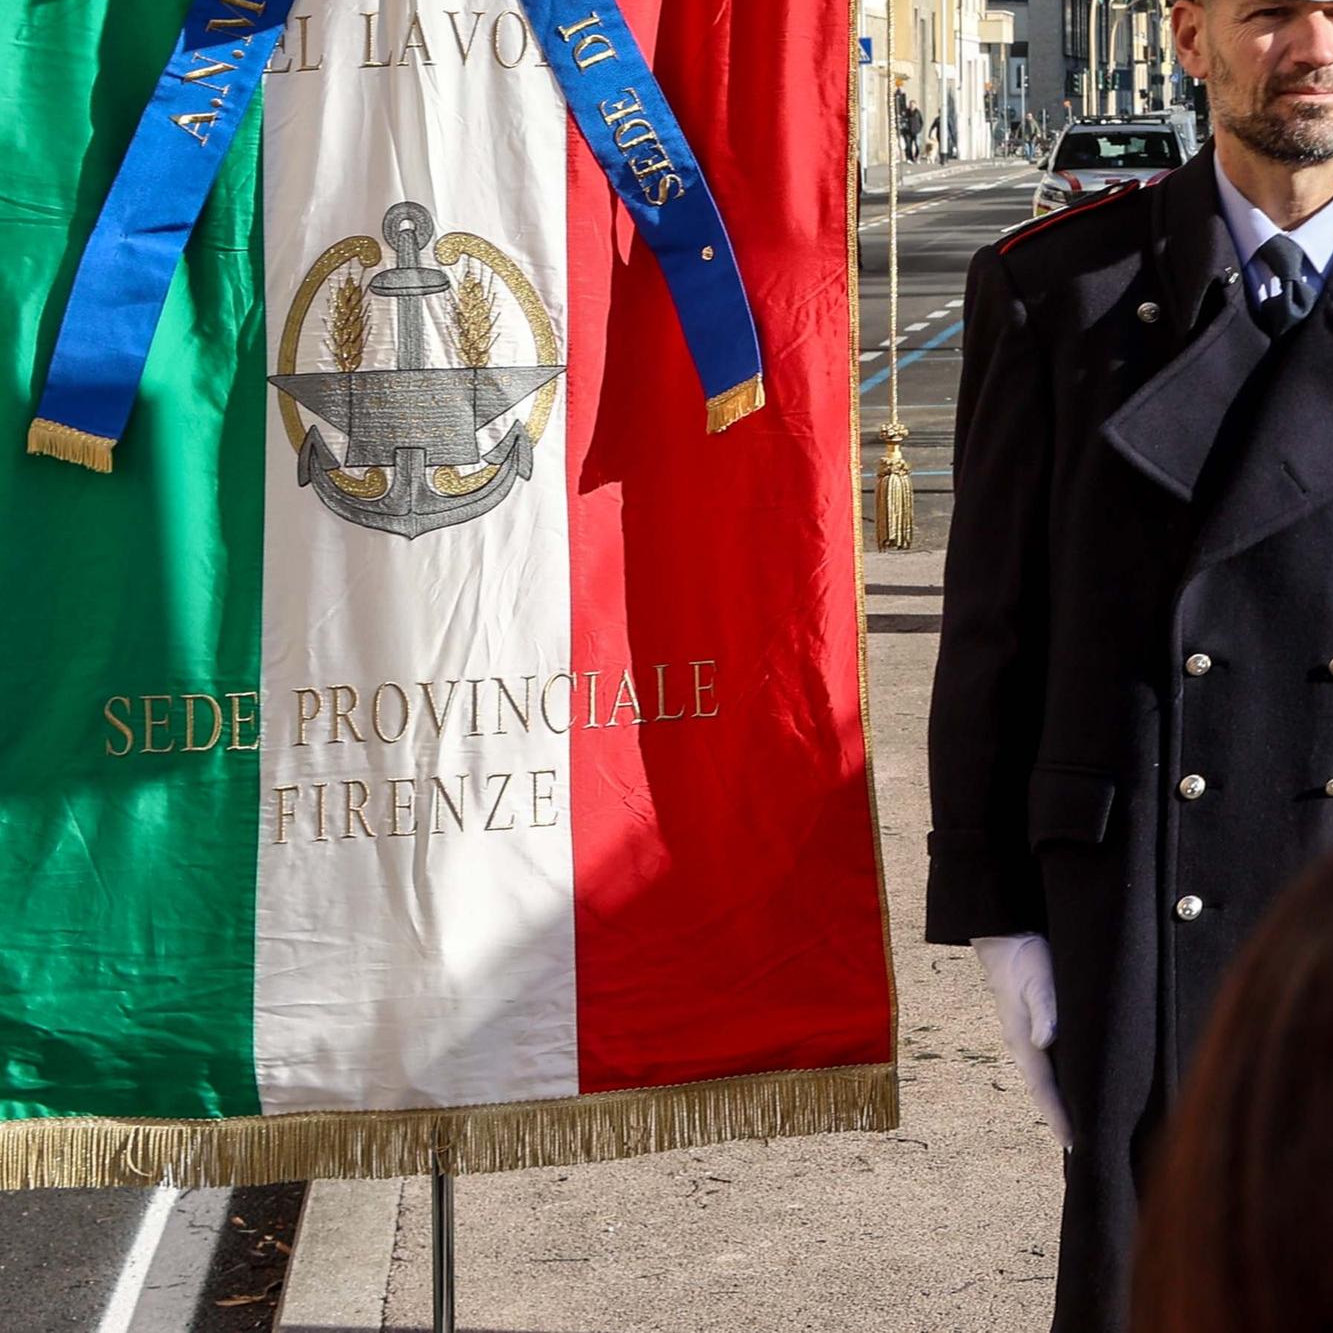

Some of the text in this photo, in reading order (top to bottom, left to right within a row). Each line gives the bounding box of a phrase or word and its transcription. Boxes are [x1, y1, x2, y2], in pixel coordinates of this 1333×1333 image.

[359, 10, 550, 68] LAVO
[559, 10, 616, 72] DI
[599, 87, 684, 206] SEDE
[104, 660, 720, 756] SEDE PROVINCIALE
[271, 769, 560, 846] FIRENZE
